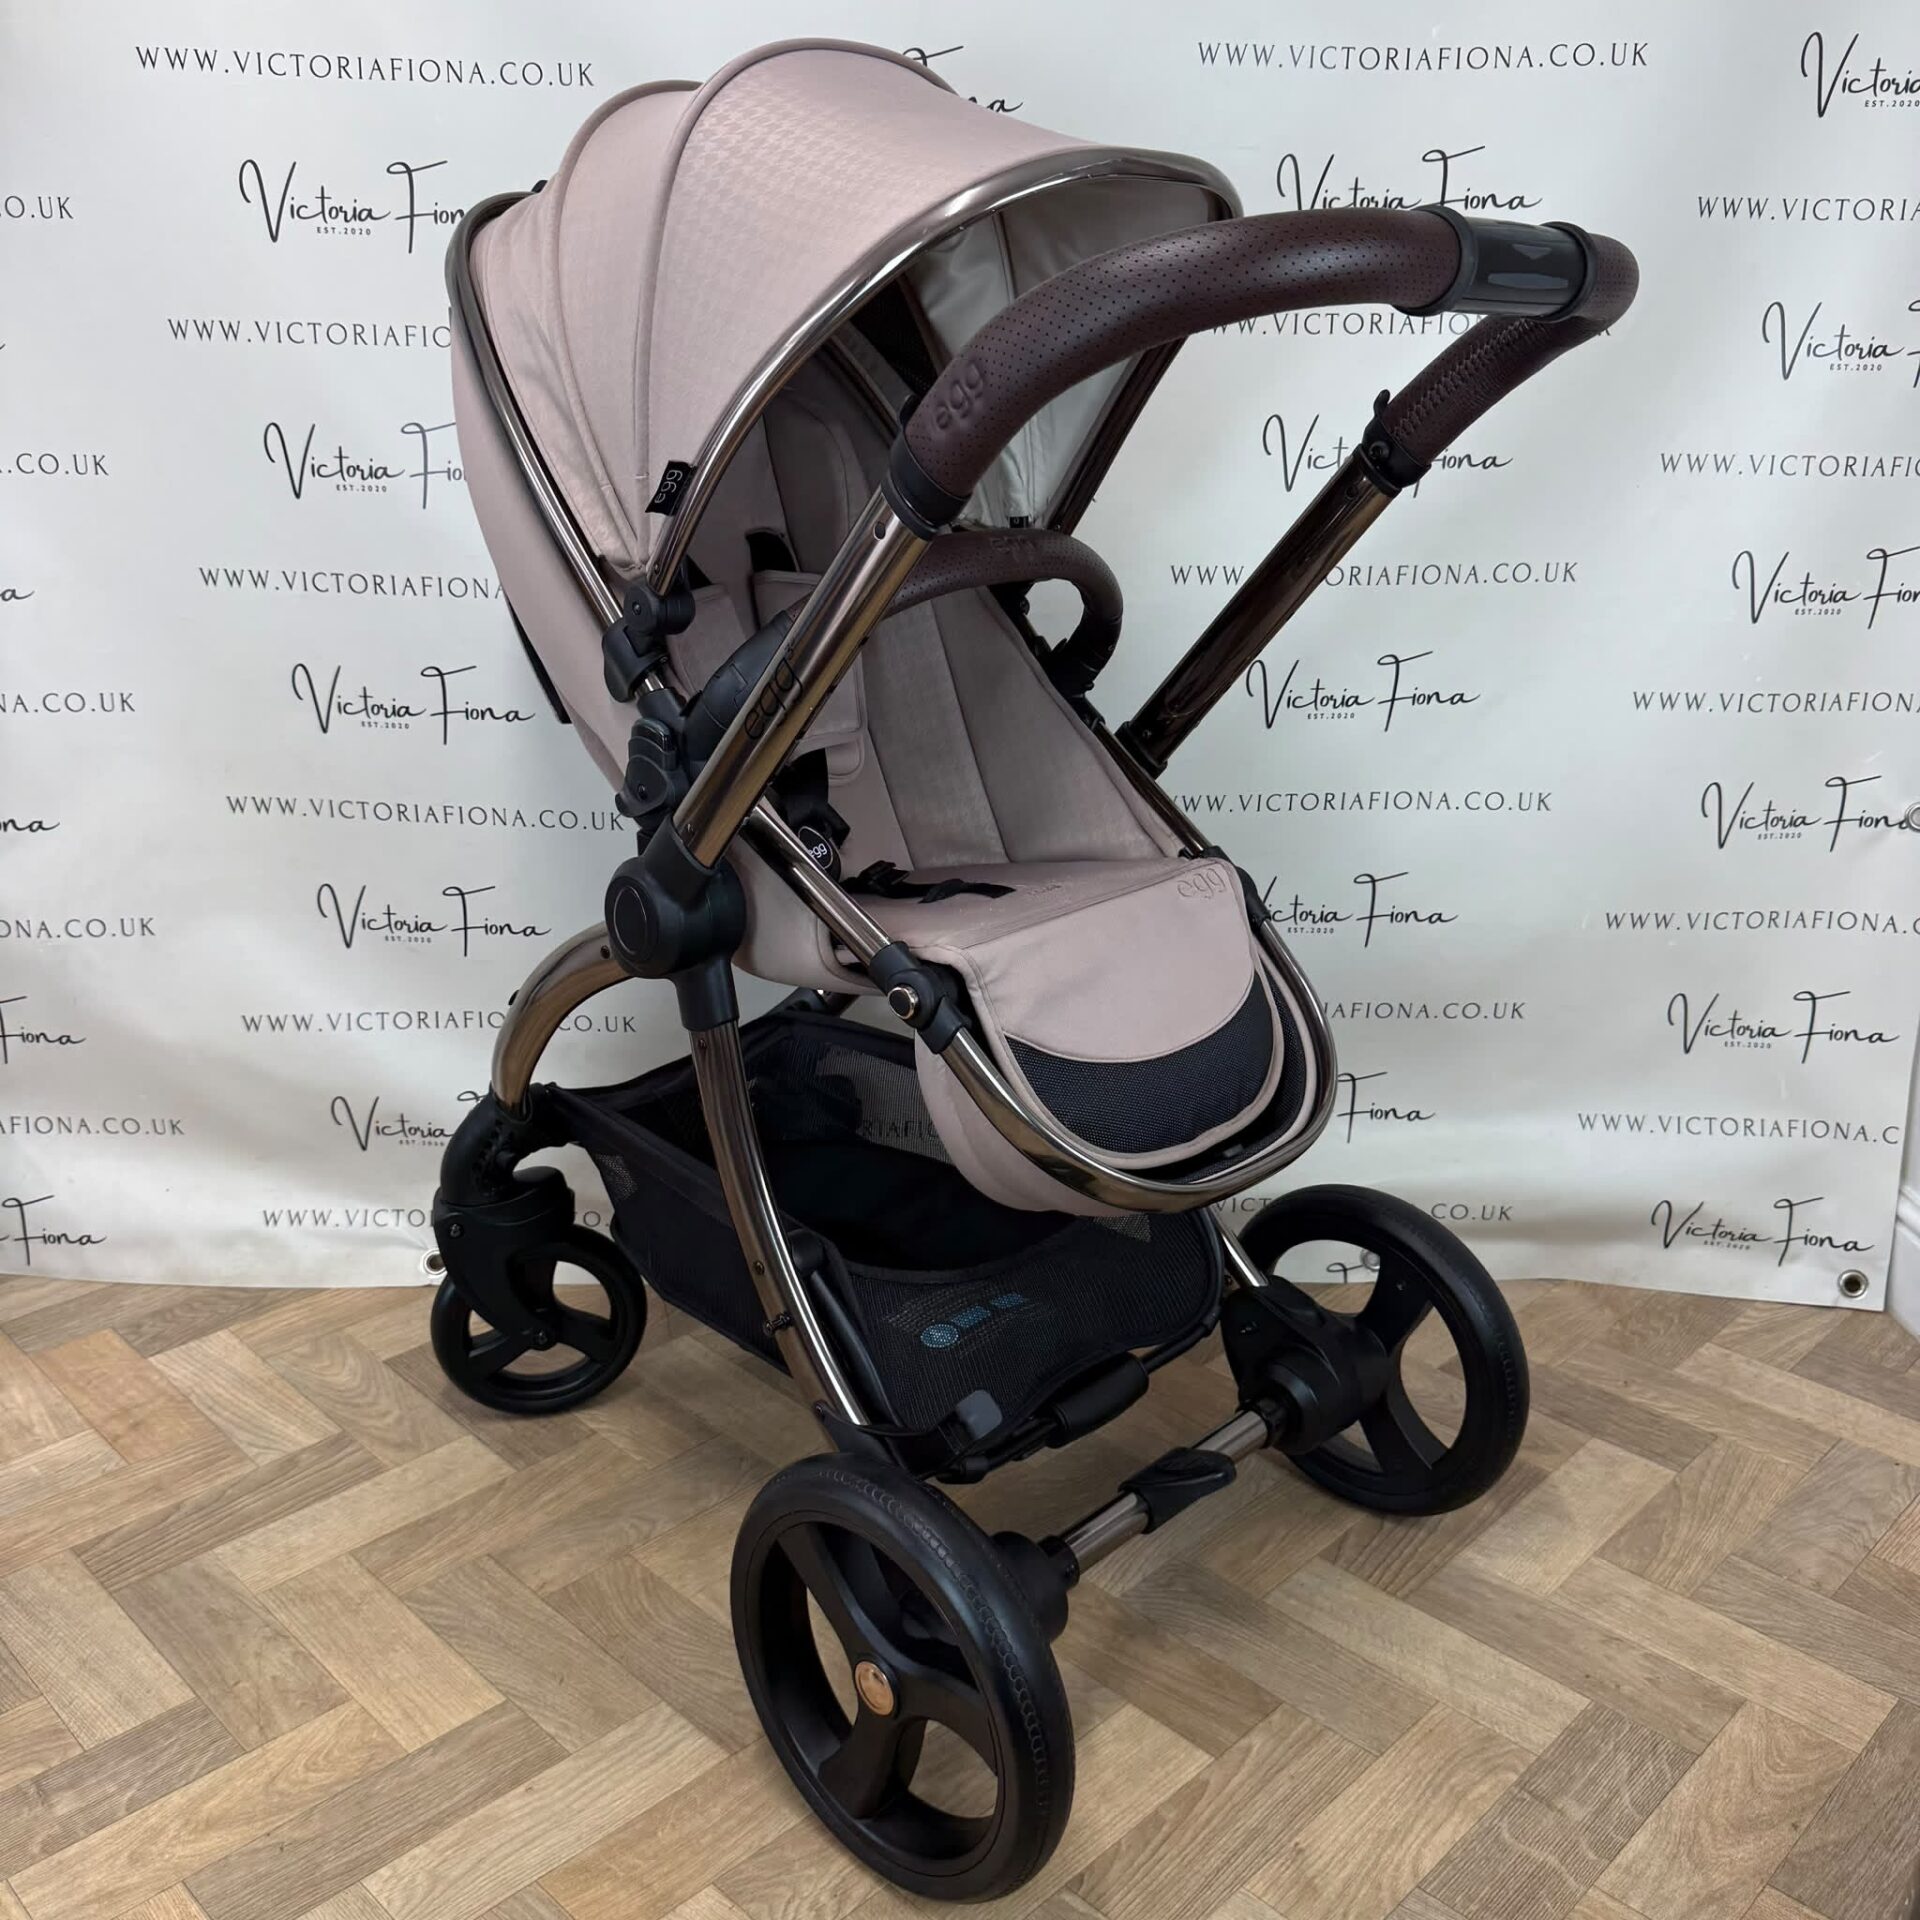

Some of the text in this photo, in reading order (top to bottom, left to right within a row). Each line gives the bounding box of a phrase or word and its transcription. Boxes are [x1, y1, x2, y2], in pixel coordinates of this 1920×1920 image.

[135, 46, 594, 86] WWW.VICTORIAFIONA.CO.UK
[1198, 42, 1648, 70] WWW.VICTORIAFIONA.CO.UK
[239, 159, 465, 254] Victoria Fion
[315, 225, 372, 237] EST.2020
[1762, 301, 1905, 381] Victoria
[1828, 362, 1884, 373] EST.2020
[264, 422, 467, 510] Victoria Fio
[654, 470, 683, 504] egg
[1262, 414, 1350, 492] Vict
[1660, 453, 1920, 478] WWW.VICTORIAFI
[335, 483, 388, 494] EST.2020
[1732, 550, 1862, 624] Victoria
[292, 663, 535, 745] Victoria Fiona
[744, 656, 804, 740] egg
[1246, 651, 1480, 732] Victoria Fiona
[1307, 712, 1356, 720] EST.2020
[1633, 691, 1920, 713] WWW.VICTORIAFION
[227, 796, 625, 831] WWW.VICTORIAFIONA.CO.UK
[1175, 791, 1551, 812] WW.VICTORIAFIONA.CO.UK
[1701, 782, 1822, 849] Victoria
[317, 884, 551, 957] Victoria Fiona
[1262, 872, 1458, 948] ictoria Fiona
[1667, 991, 1900, 1064] Victoria Fiona
[331, 1096, 455, 1152] Victoria
[1337, 1072, 1435, 1143] Fiona
[1578, 1113, 1899, 1144] WWW.VICTORIAFIONA.C
[2, 1194, 107, 1266] Fiona
[1651, 1197, 1875, 1267] Victoria Fiona
